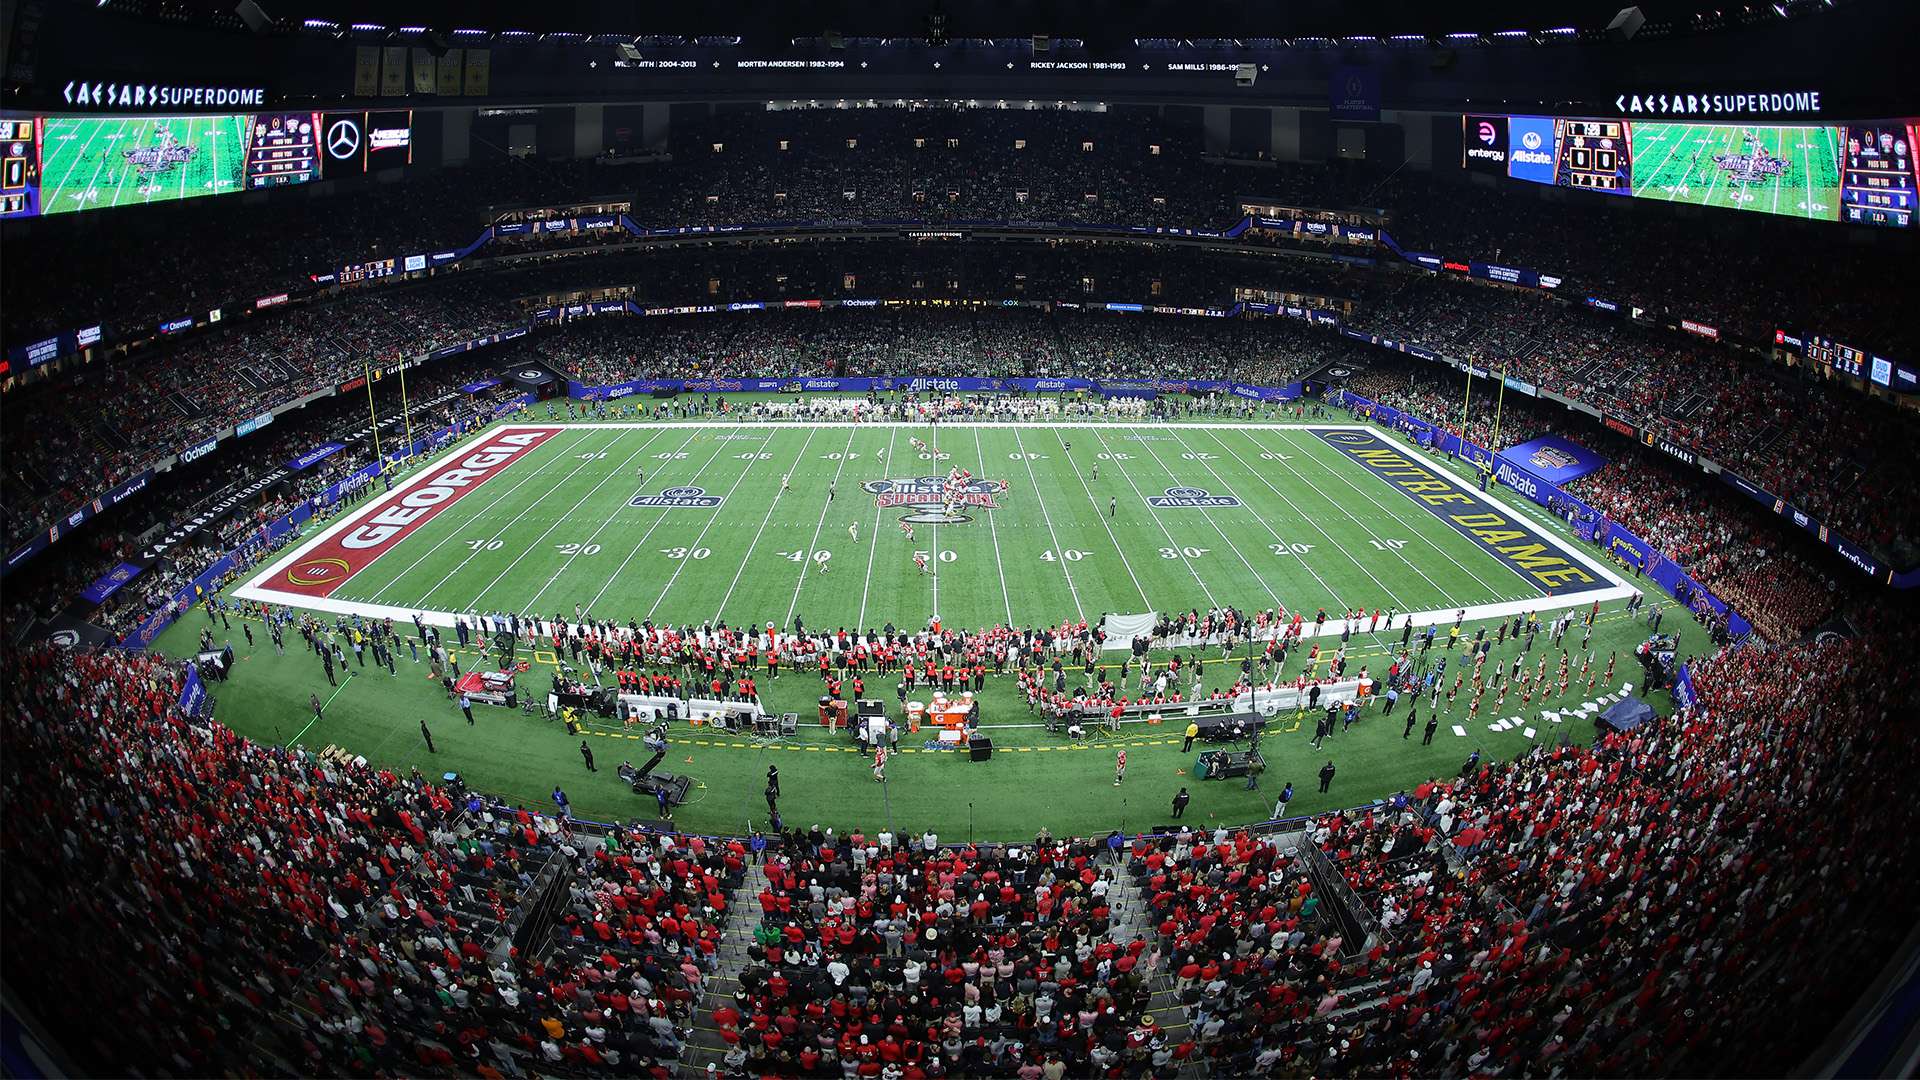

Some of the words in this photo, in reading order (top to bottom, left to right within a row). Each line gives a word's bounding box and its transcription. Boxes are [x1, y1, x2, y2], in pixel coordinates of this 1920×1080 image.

[737, 60, 767, 68] MORTEN
[768, 60, 805, 68] ANDERSEN
[810, 60, 844, 68] 1982-1994
[1092, 62, 1126, 70] 1981-1993
[1168, 63, 1184, 71] SAM
[1184, 63, 1205, 71] MILLS
[1468, 148, 1504, 161] entergy
[1443, 262, 1469, 271] verizon
[846, 299, 877, 307] Ochsner
[1595, 299, 1616, 311] Chevron
[169, 319, 192, 331] Chevron
[1783, 335, 1802, 347] TOYOTA
[1234, 382, 1259, 398] Allstate
[1604, 416, 1634, 438] verizon
[185, 439, 217, 462] Ochsner
[1659, 441, 1693, 465] CAESARS
[340, 430, 547, 549] GEORGIA
[634, 497, 712, 505] Allstate
[876, 492, 940, 508] SUGAR
[1156, 497, 1232, 505] Allstate
[1347, 448, 1476, 507] NOTRE
[1449, 512, 1595, 588] DAME
[557, 542, 602, 555] 20
[1268, 542, 1311, 556] 20
[1368, 538, 1403, 551] 10
[667, 547, 712, 559] 30
[1039, 549, 1083, 562] 40
[1158, 547, 1202, 560] 30
[935, 714, 944, 722] G
